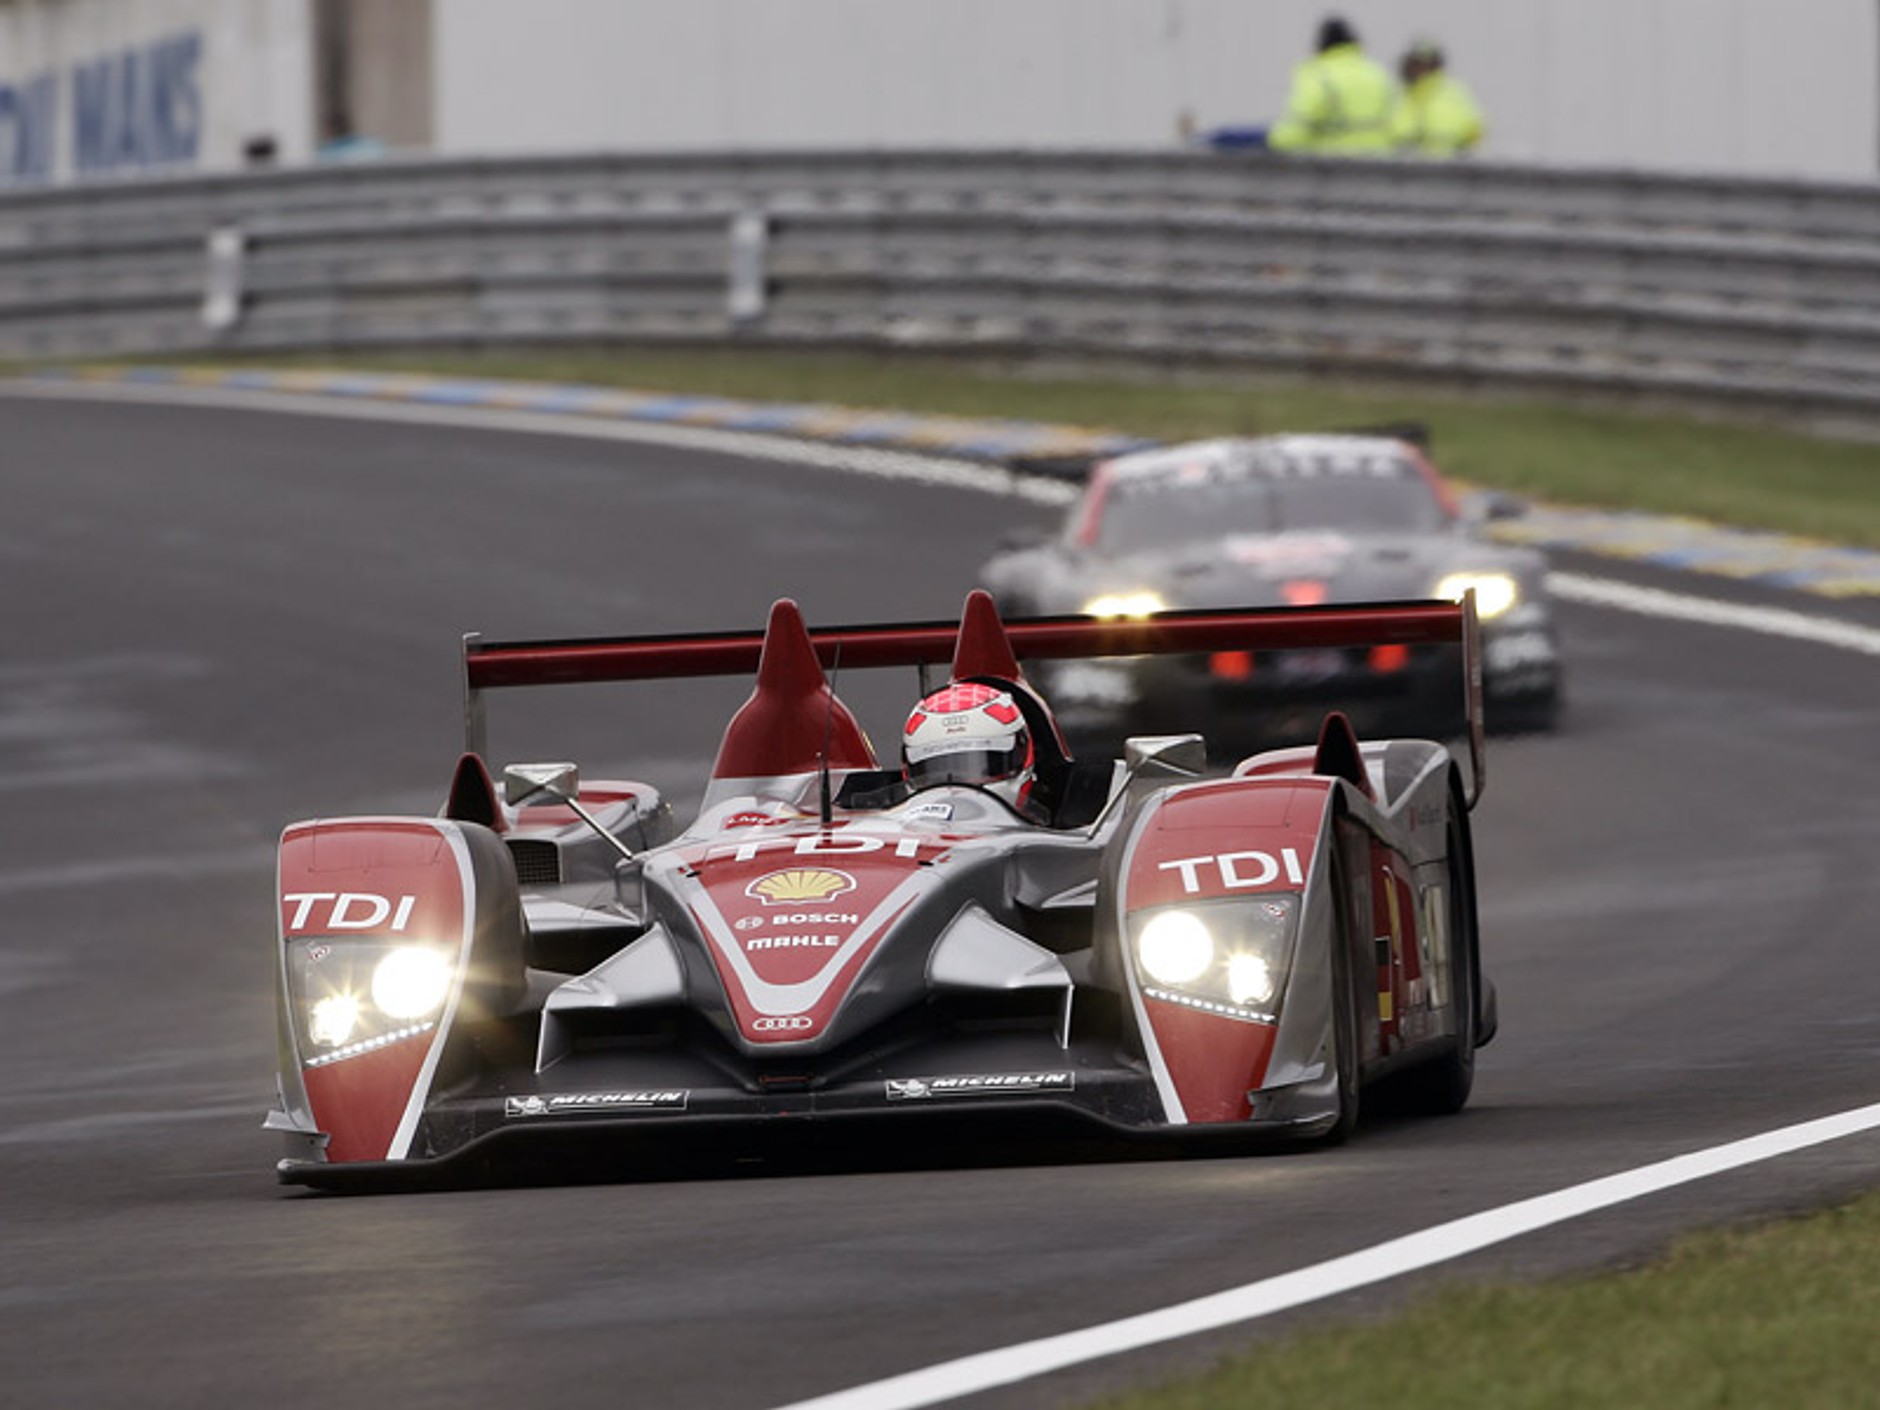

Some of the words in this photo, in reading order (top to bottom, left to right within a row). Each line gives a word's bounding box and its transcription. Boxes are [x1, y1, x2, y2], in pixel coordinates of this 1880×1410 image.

[1158, 848, 1304, 893] TDI
[283, 892, 416, 931] TDI
[772, 913, 859, 925] BOSCH
[932, 1073, 1068, 1088] MICHELIN
[550, 1092, 683, 1105] MICHELIN
